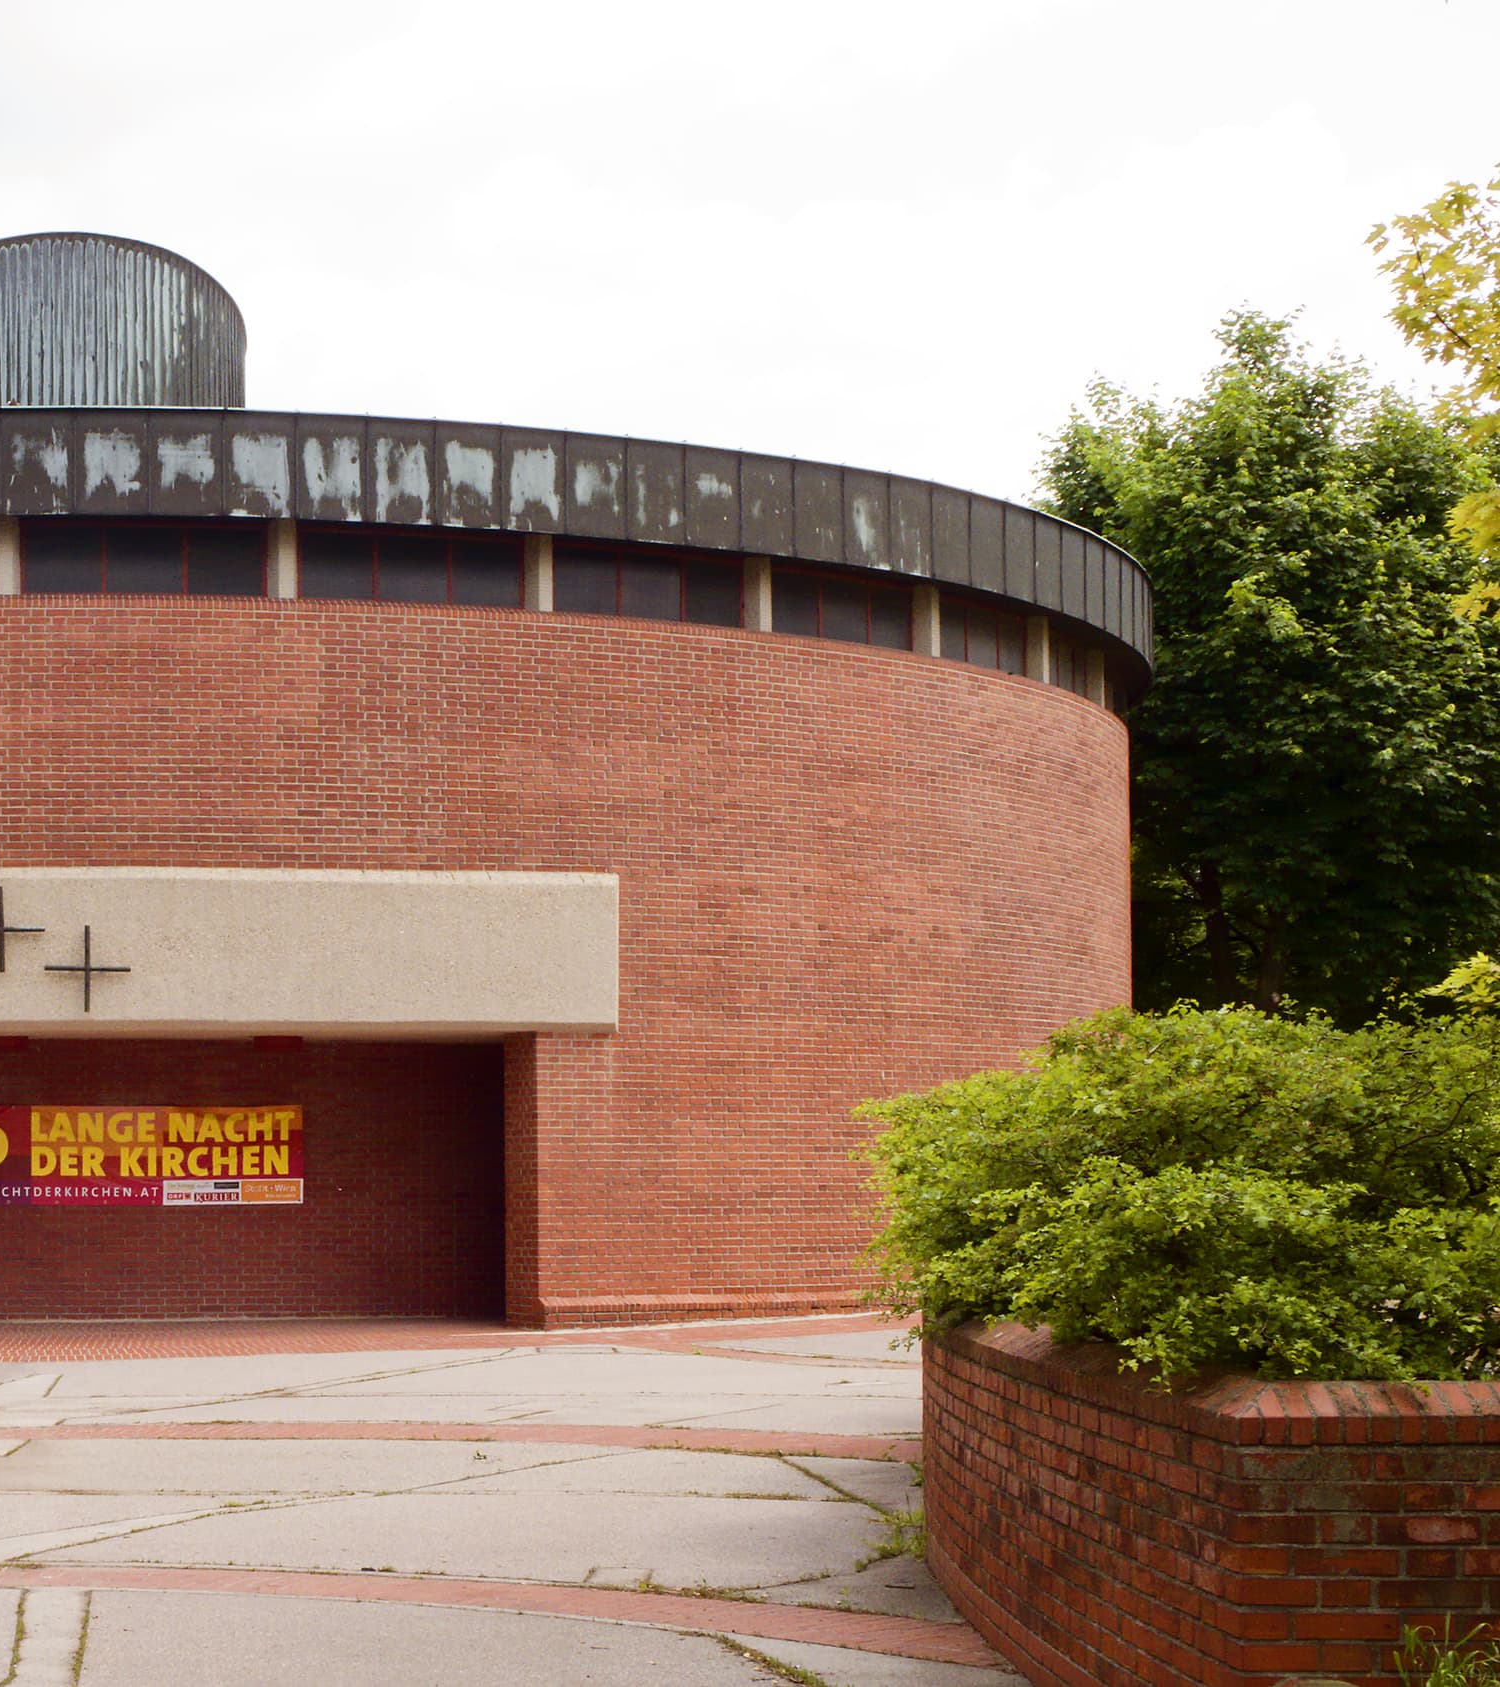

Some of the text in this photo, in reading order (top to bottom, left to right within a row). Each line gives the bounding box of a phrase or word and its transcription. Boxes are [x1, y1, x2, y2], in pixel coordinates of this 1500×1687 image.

[31, 1111, 295, 1143] LANGE NACHT
[32, 1145, 289, 1177] DER KIRCHEN
[195, 1192, 239, 1202] KURIER
